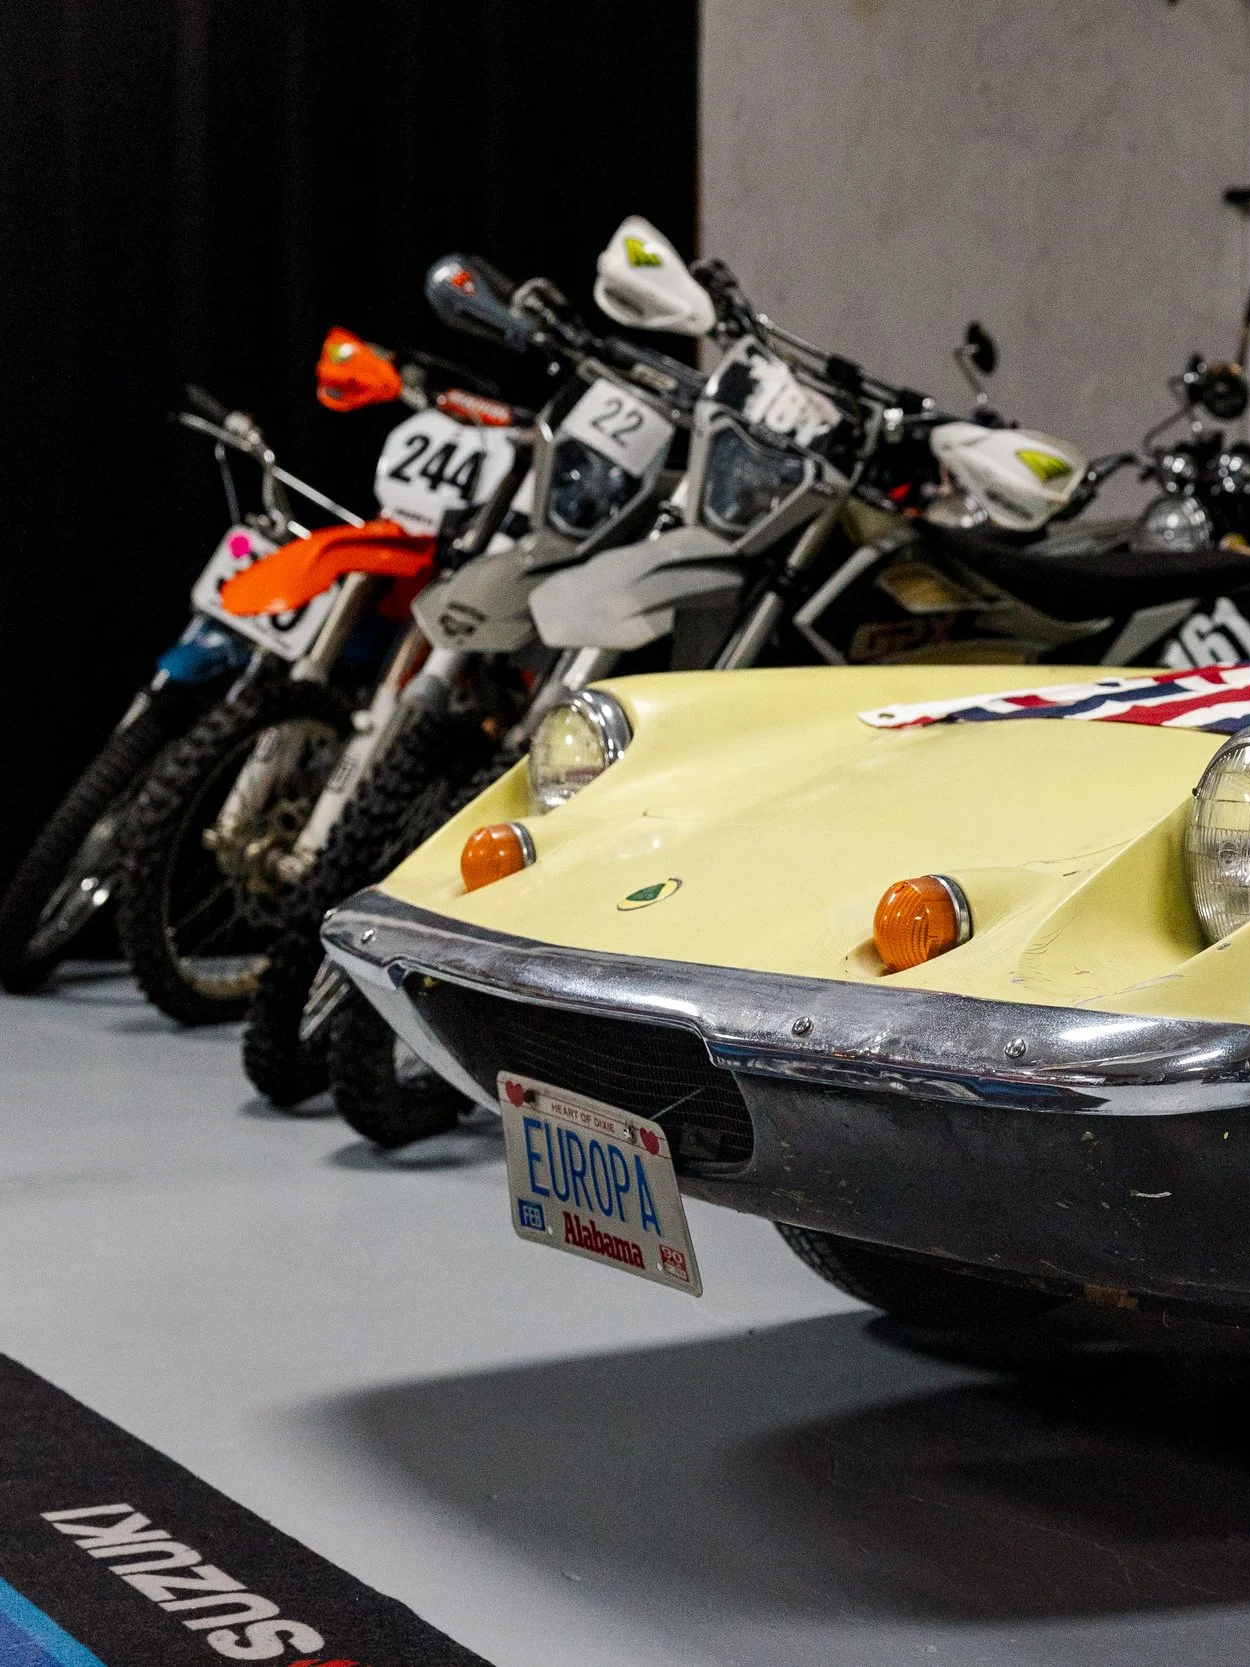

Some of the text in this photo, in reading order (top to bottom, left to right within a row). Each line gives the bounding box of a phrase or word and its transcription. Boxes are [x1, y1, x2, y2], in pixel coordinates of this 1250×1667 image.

[590, 396, 644, 449] 22
[389, 434, 487, 503] 244
[551, 1103, 615, 1134] HEART OF DIXIE
[522, 1115, 661, 1237] EUROPA
[522, 1205, 543, 1228] FEB
[563, 1210, 645, 1270] Alabama
[40, 1503, 325, 1660] SUZUKI
